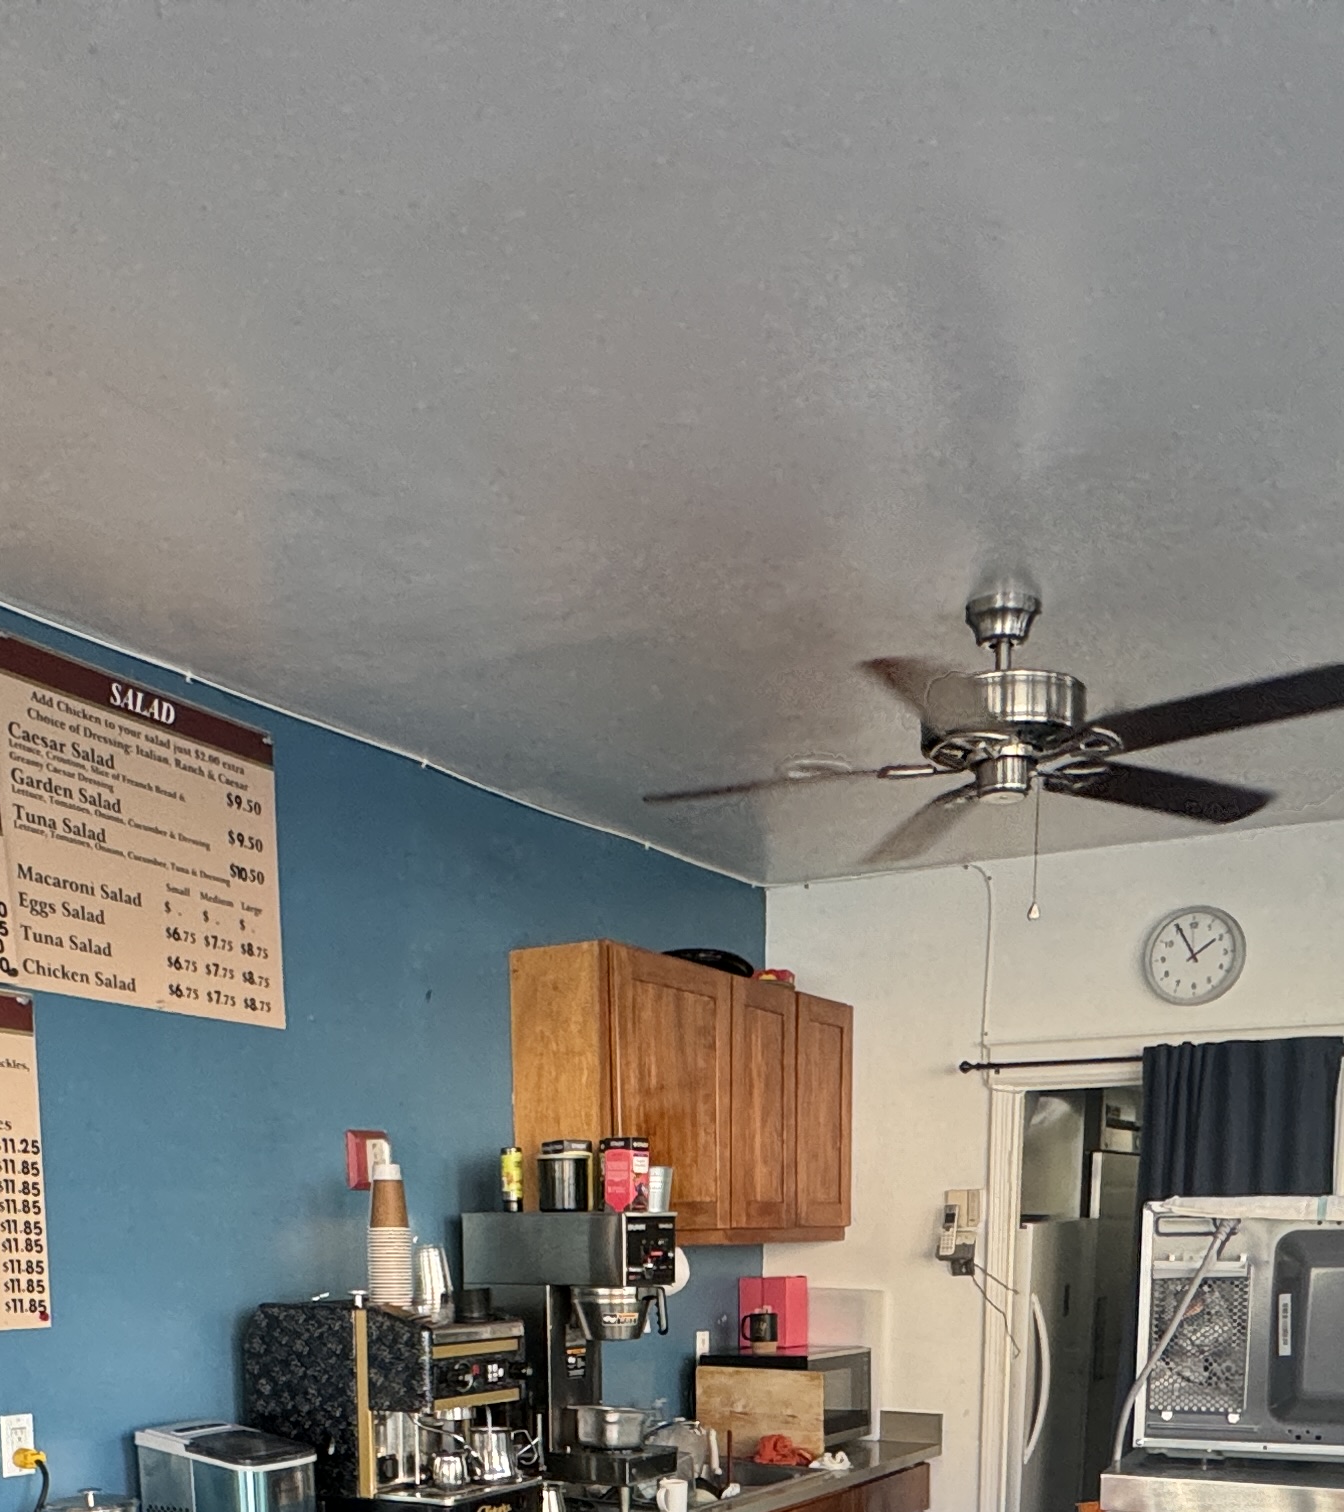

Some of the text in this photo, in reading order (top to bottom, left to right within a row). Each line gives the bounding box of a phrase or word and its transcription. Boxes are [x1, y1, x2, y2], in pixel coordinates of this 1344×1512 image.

[109, 682, 175, 724] SALAD
[7, 720, 262, 815] Caesar Salad $9.50
[10, 766, 263, 853] Garden Salad $9.50
[17, 890, 269, 959] Eggs Salad $6.75 $7.75 $8.75
